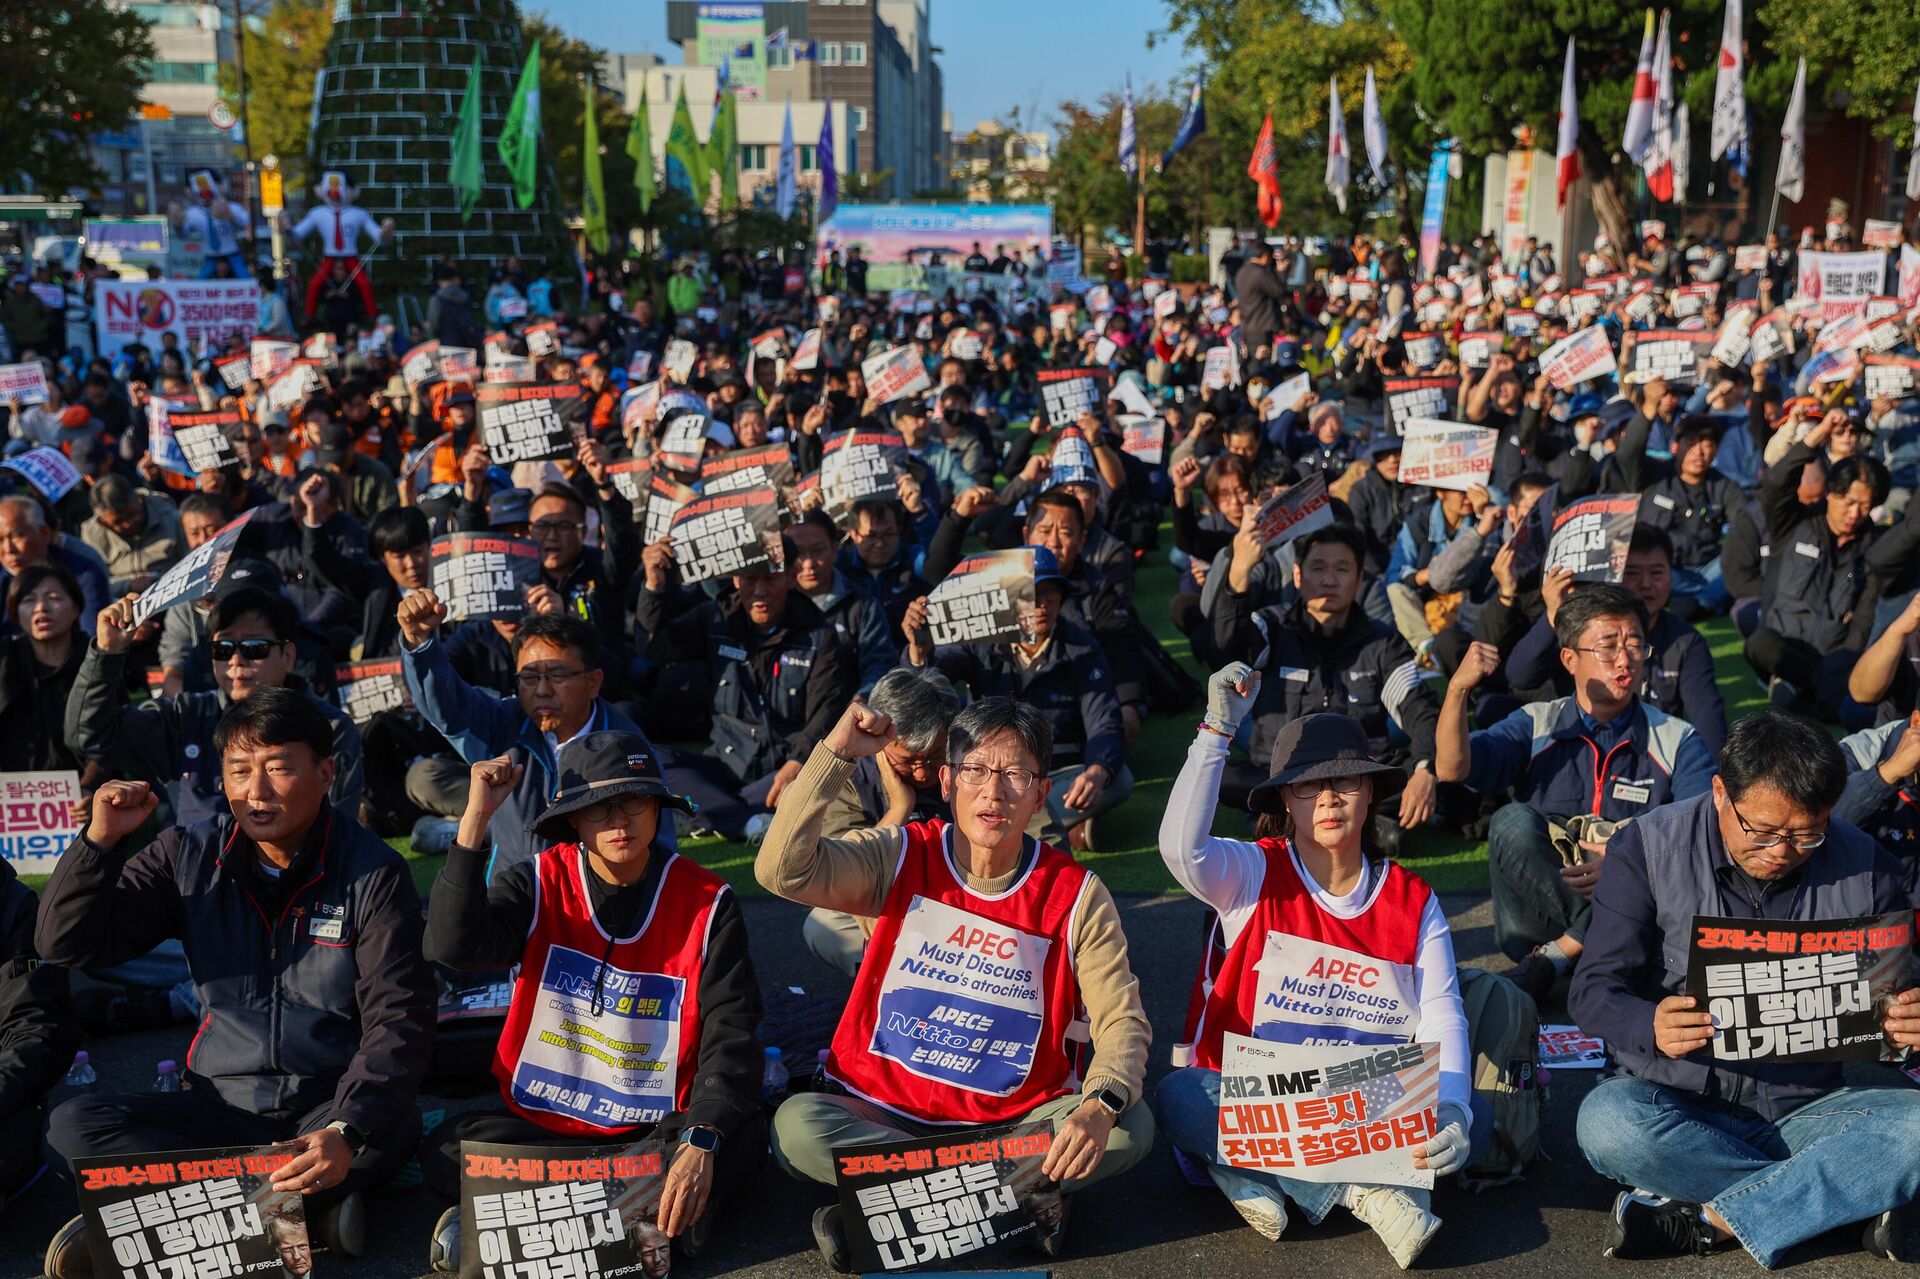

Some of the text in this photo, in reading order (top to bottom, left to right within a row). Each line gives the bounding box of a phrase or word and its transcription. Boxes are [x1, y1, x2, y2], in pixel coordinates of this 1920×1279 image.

[929, 614, 997, 646] 나가라!
[946, 924, 1018, 960] APEC
[1697, 927, 1797, 953] 경제수탈!
[1800, 930, 1866, 954] 일자리
[918, 941, 1032, 983] Must Discuss
[1306, 956, 1380, 988] APEC
[1705, 952, 1858, 997] 트럼프는
[549, 999, 564, 1011] We
[971, 981, 1039, 1001] atrocities!
[1280, 975, 1399, 1011] Must Discuss
[1708, 980, 1871, 1030] 이 땅에서
[928, 1005, 994, 1032] APEC는
[1335, 1005, 1409, 1025] atrocities!
[538, 1031, 667, 1072] Nitto's runaway behavior
[559, 1018, 650, 1055] Japanese company
[987, 1039, 1023, 1058] 만행
[1712, 1017, 1839, 1061] 나가라!
[910, 1046, 982, 1074] 논의하라!
[1221, 1043, 1425, 1099] 제2 IMF 불러오는
[525, 1079, 593, 1112] 세계인에
[612, 1074, 663, 1088] to the world
[1219, 1090, 1368, 1135] 대미 투자
[1223, 1108, 1437, 1168] 전면 철회하라
[81, 1162, 176, 1190] 경제수탈!
[179, 1158, 242, 1181] 일자리
[464, 1154, 544, 1181] 경제수탈!
[547, 1159, 609, 1181] 일자리
[839, 1149, 933, 1176] 경제수탈!
[935, 1140, 999, 1168] 일자리
[98, 1177, 246, 1237] 트럼프는
[473, 1181, 608, 1230] 트럼프는
[855, 1162, 1001, 1217] 트럼프는
[867, 1184, 1019, 1243] 이 땅에서
[112, 1202, 264, 1268] 이 땅에서
[478, 1208, 626, 1265] 이 땅에서
[877, 1219, 997, 1270] 나가라!
